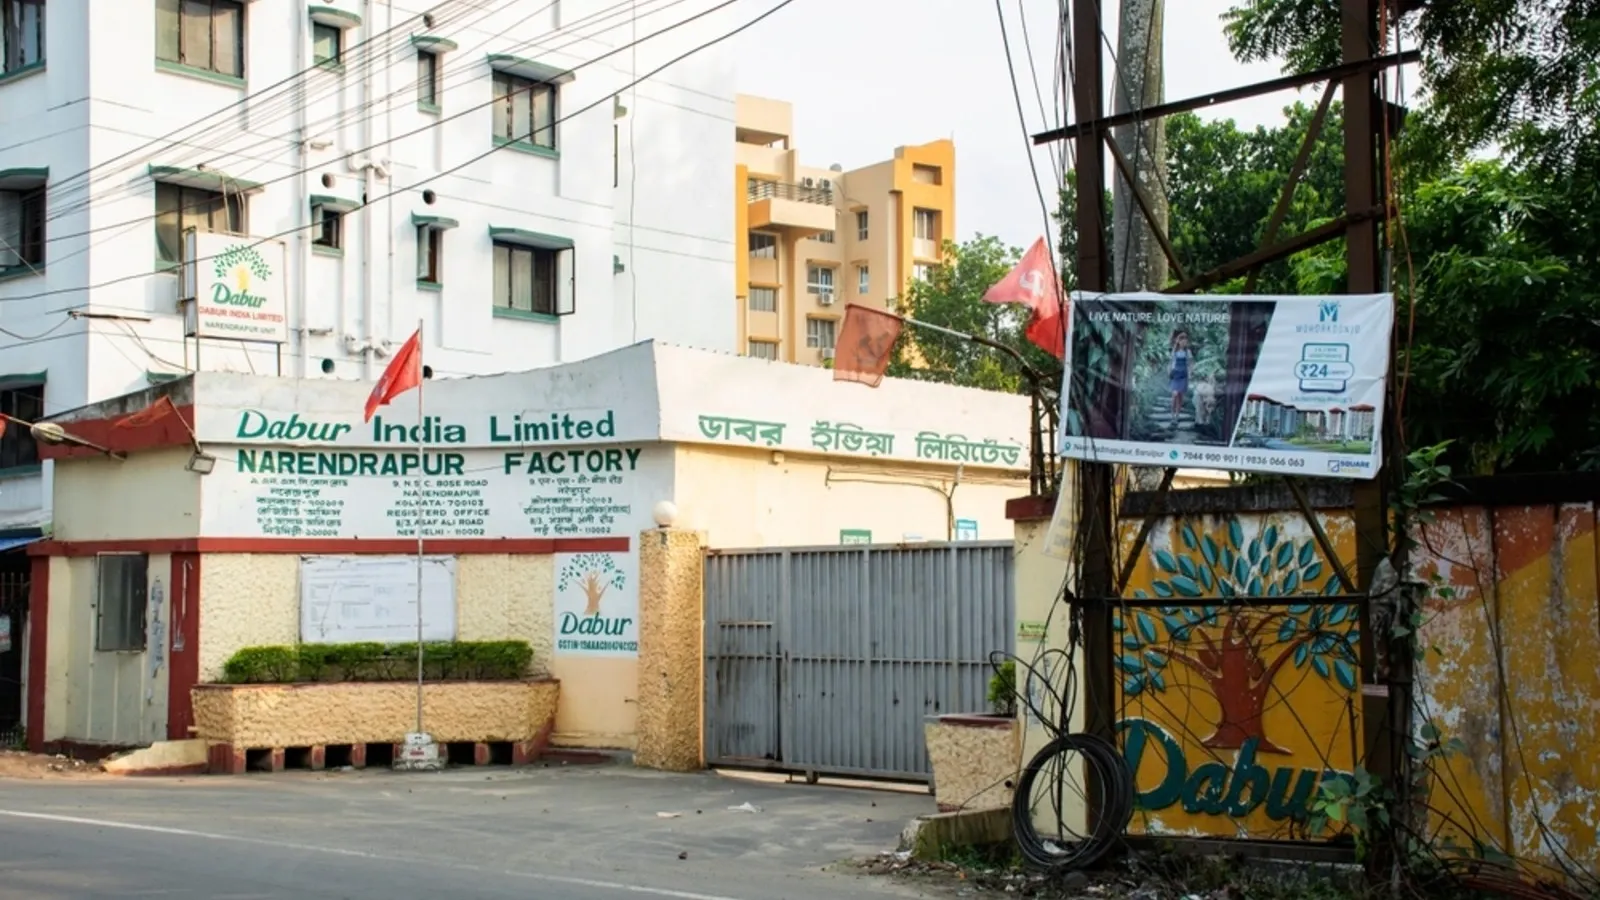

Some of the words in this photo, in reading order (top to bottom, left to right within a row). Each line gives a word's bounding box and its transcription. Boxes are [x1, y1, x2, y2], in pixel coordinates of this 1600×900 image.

[210, 282, 267, 308] Dabur
[198, 306, 228, 317] DABUR
[229, 309, 251, 319] INDIA
[252, 311, 284, 323] LIMITED
[1089, 311, 1110, 321] LIVE
[1157, 312, 1184, 323] LOVE
[204, 321, 258, 333] NARENDRAPUR
[237, 410, 352, 442] Dabur
[373, 415, 467, 443] India
[491, 410, 616, 442] Limited
[698, 415, 787, 446] ডাবর
[237, 449, 465, 476] NARENDRAPUR
[504, 448, 642, 475] FACTORY
[463, 479, 489, 487] ROAD
[559, 611, 633, 635] Dabur
